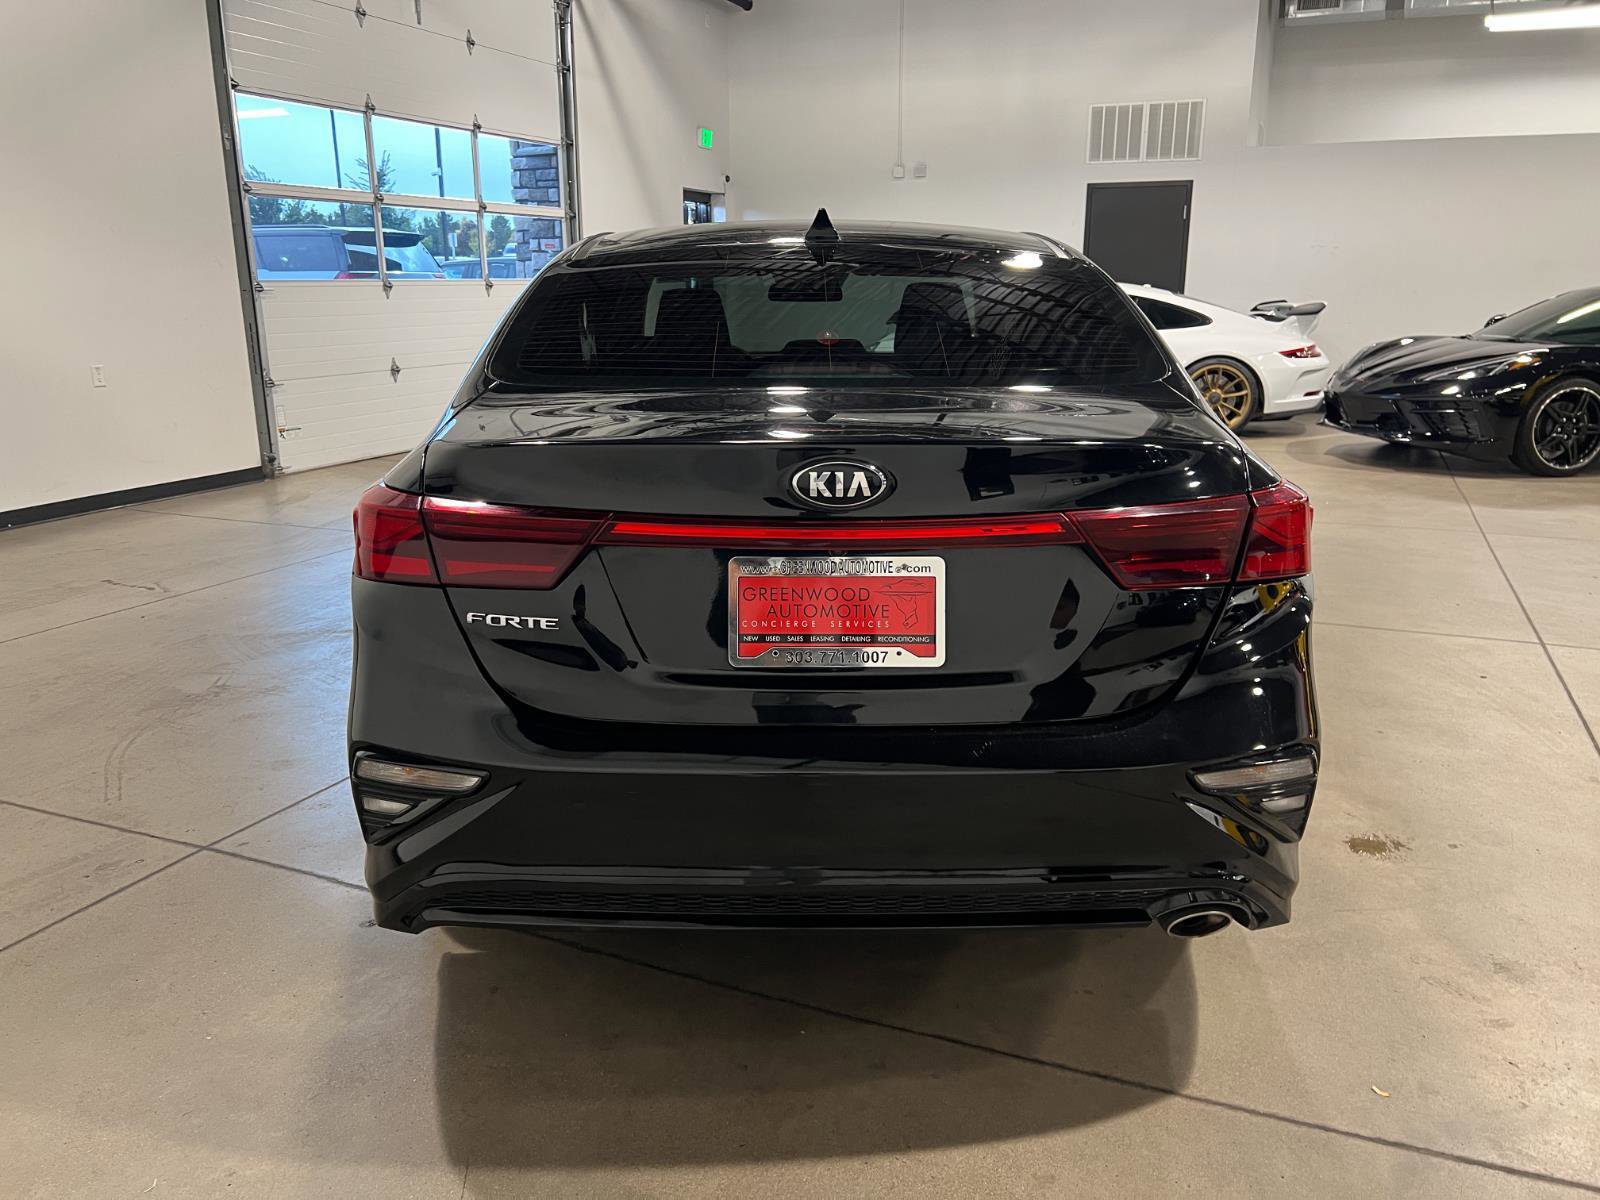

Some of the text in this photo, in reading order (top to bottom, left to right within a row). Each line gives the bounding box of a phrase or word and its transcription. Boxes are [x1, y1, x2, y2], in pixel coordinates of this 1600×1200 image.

[808, 471, 872, 498] KIA
[742, 587, 870, 602] GREENWOOD
[767, 604, 889, 619] AUTOMOTIVE
[466, 612, 560, 630] FORTE
[742, 620, 890, 628] CONCIERGE SERVICES
[786, 650, 889, 664] 303.771.1007
